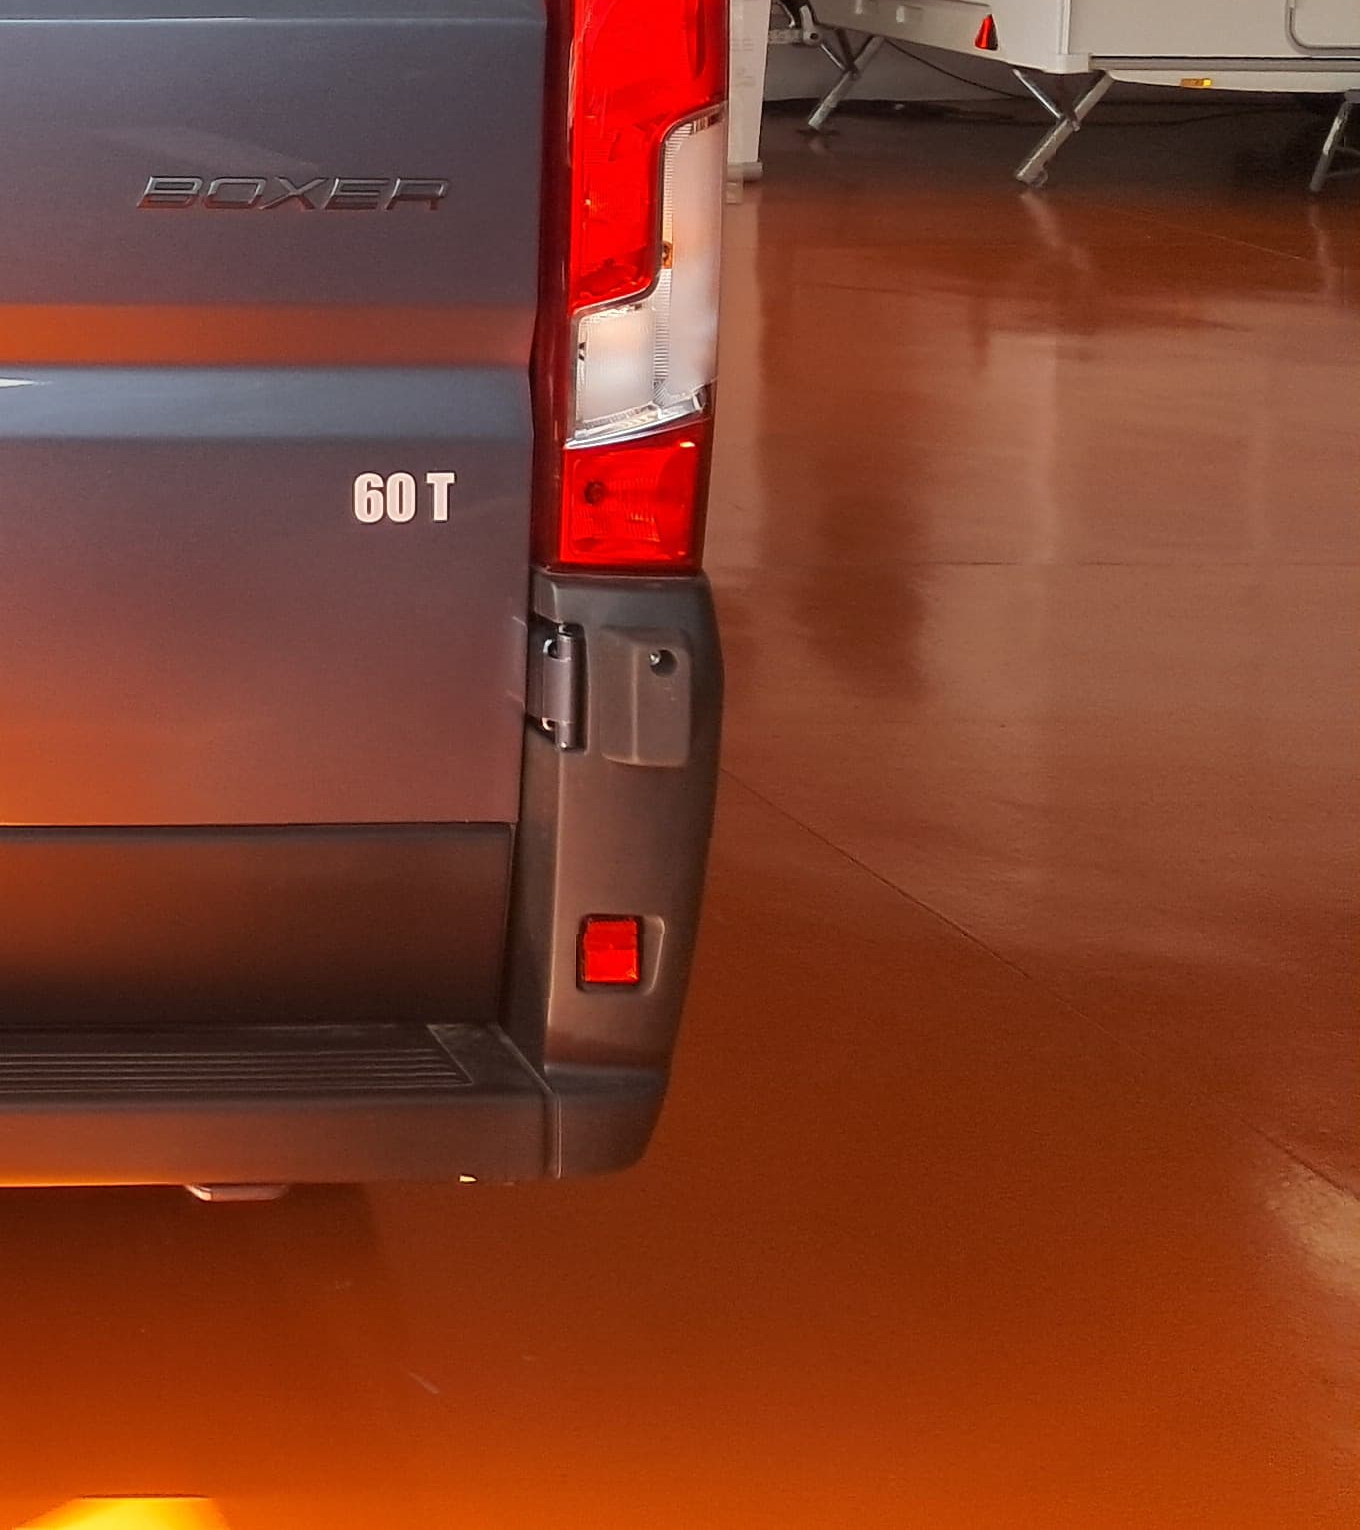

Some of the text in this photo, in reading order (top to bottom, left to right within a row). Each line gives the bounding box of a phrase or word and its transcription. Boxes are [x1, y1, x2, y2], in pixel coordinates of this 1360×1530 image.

[136, 175, 452, 213] BOXER
[353, 471, 455, 524] 60 T
